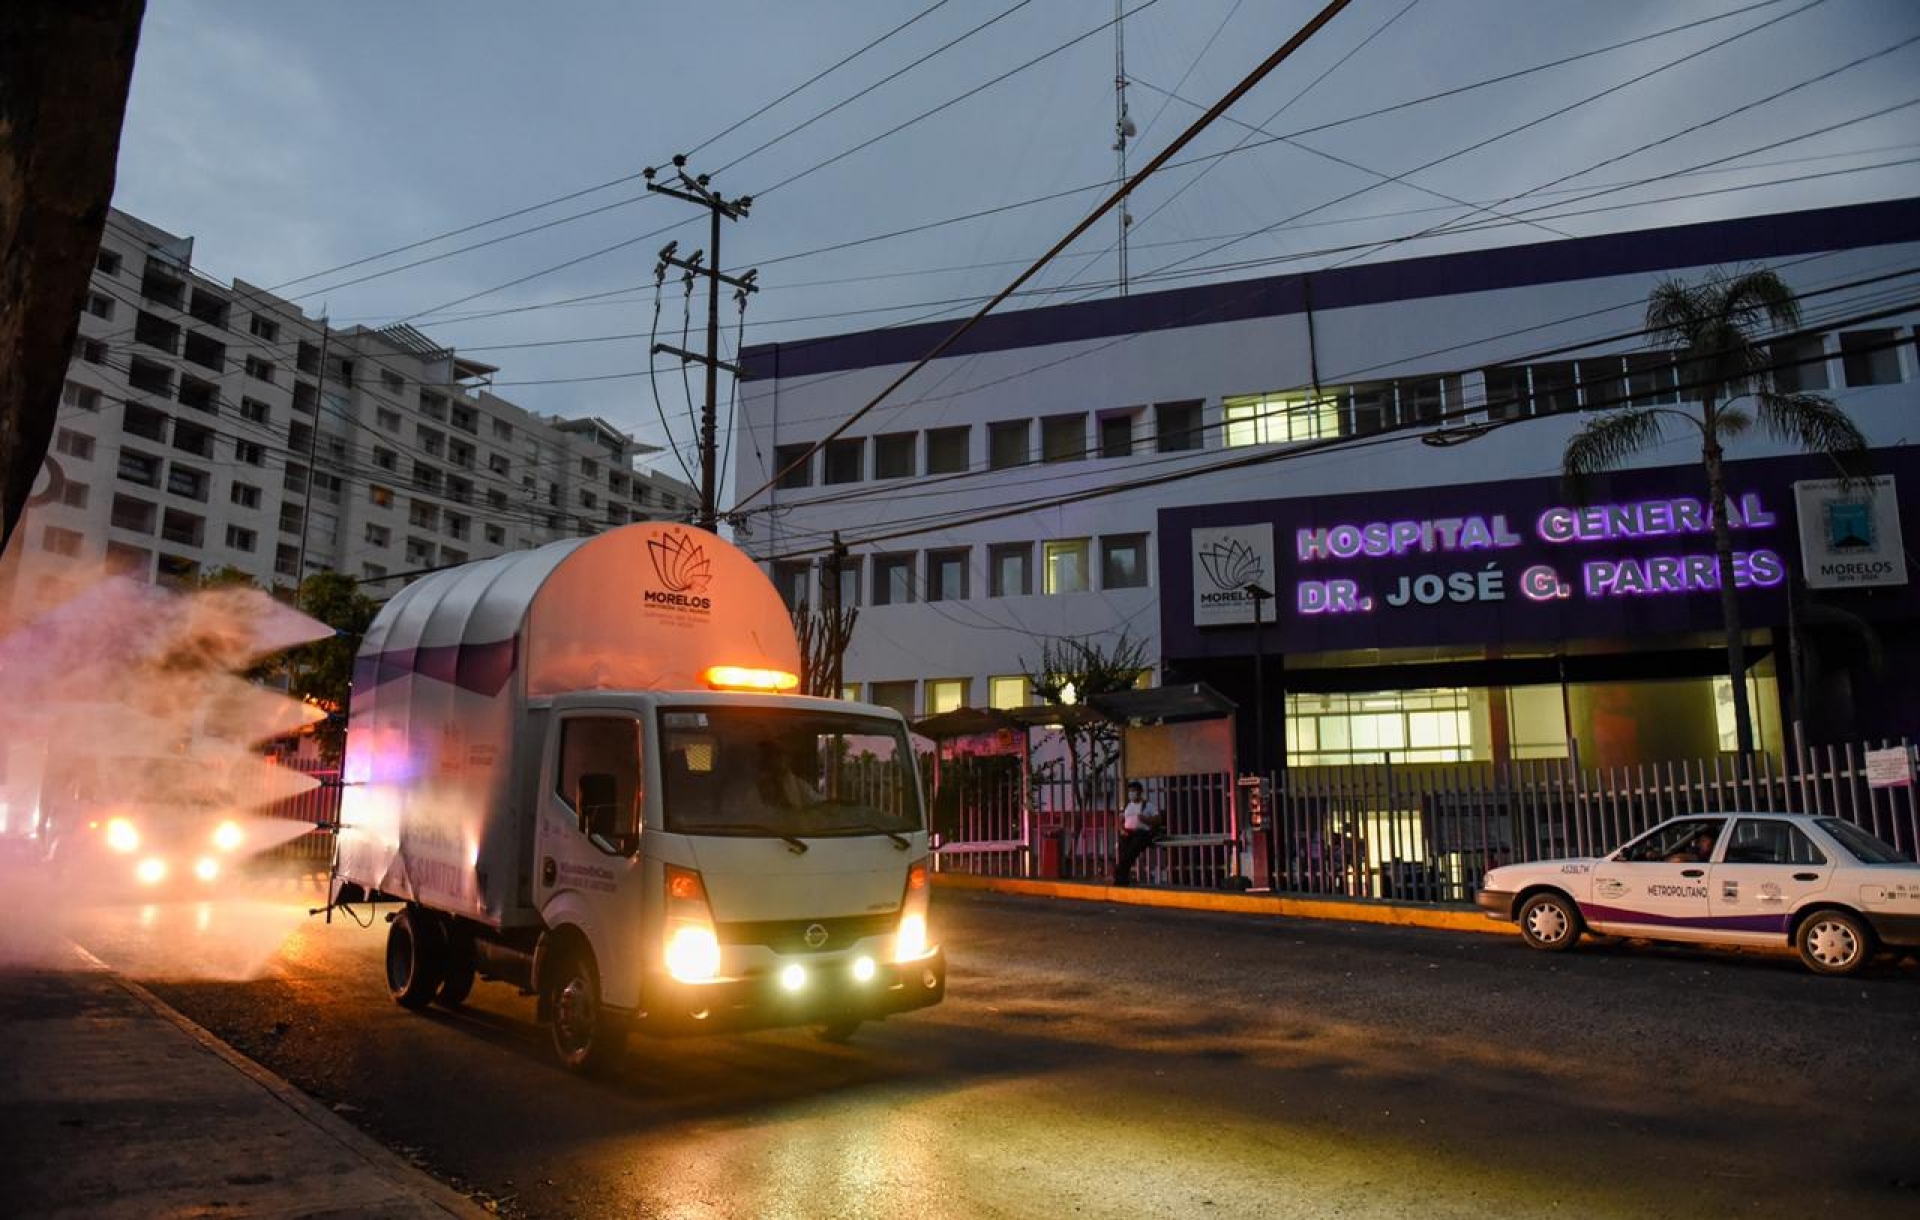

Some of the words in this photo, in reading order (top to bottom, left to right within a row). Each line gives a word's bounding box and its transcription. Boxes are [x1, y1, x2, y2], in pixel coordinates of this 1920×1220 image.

[1298, 515, 1522, 561] HOSPITAL
[1537, 494, 1775, 543] GENERAL
[1820, 561, 1893, 576] MORELOS
[1298, 579, 1372, 613] DR.
[1386, 562, 1506, 607] JOSÉ
[1521, 564, 1571, 600] G.
[1584, 549, 1785, 597] PARRES
[644, 589, 711, 609] MORELOS
[1647, 884, 1708, 898] METROPOLITANO
